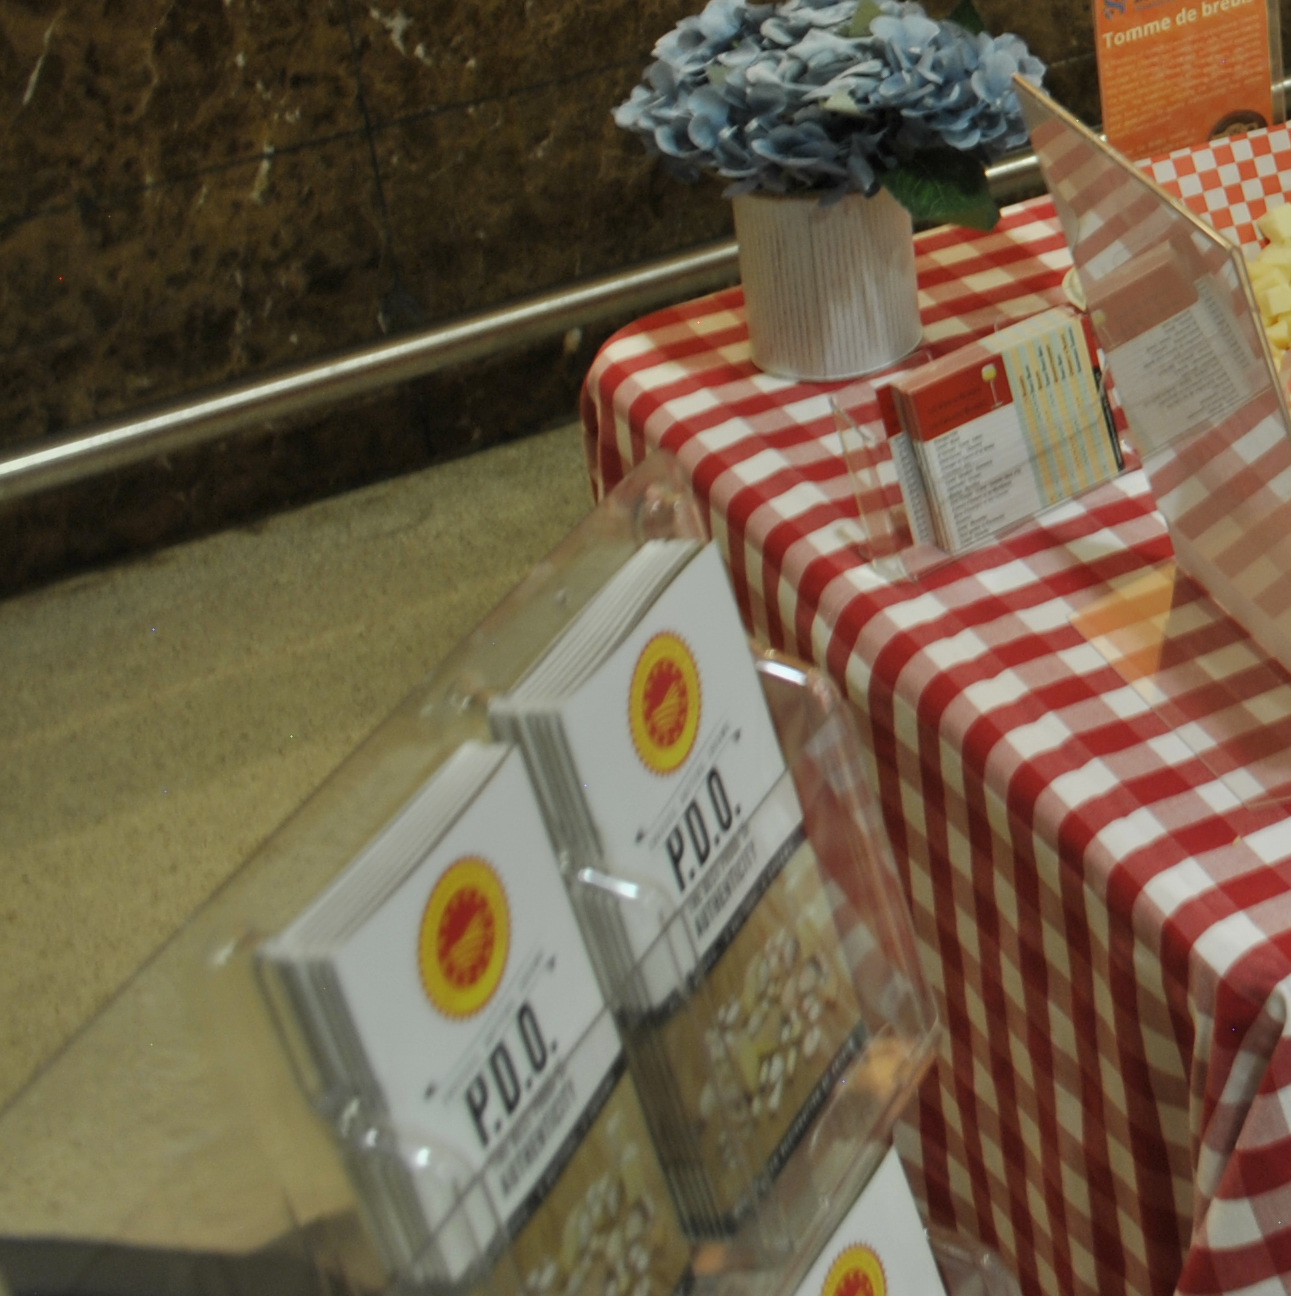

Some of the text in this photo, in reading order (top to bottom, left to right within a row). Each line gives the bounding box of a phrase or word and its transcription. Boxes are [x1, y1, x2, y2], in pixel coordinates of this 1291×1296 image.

[1102, 16, 1172, 49] Tomme
[1175, 8, 1198, 26] de
[665, 767, 741, 892] P.D.O.
[465, 1003, 558, 1147] P.D.O.
